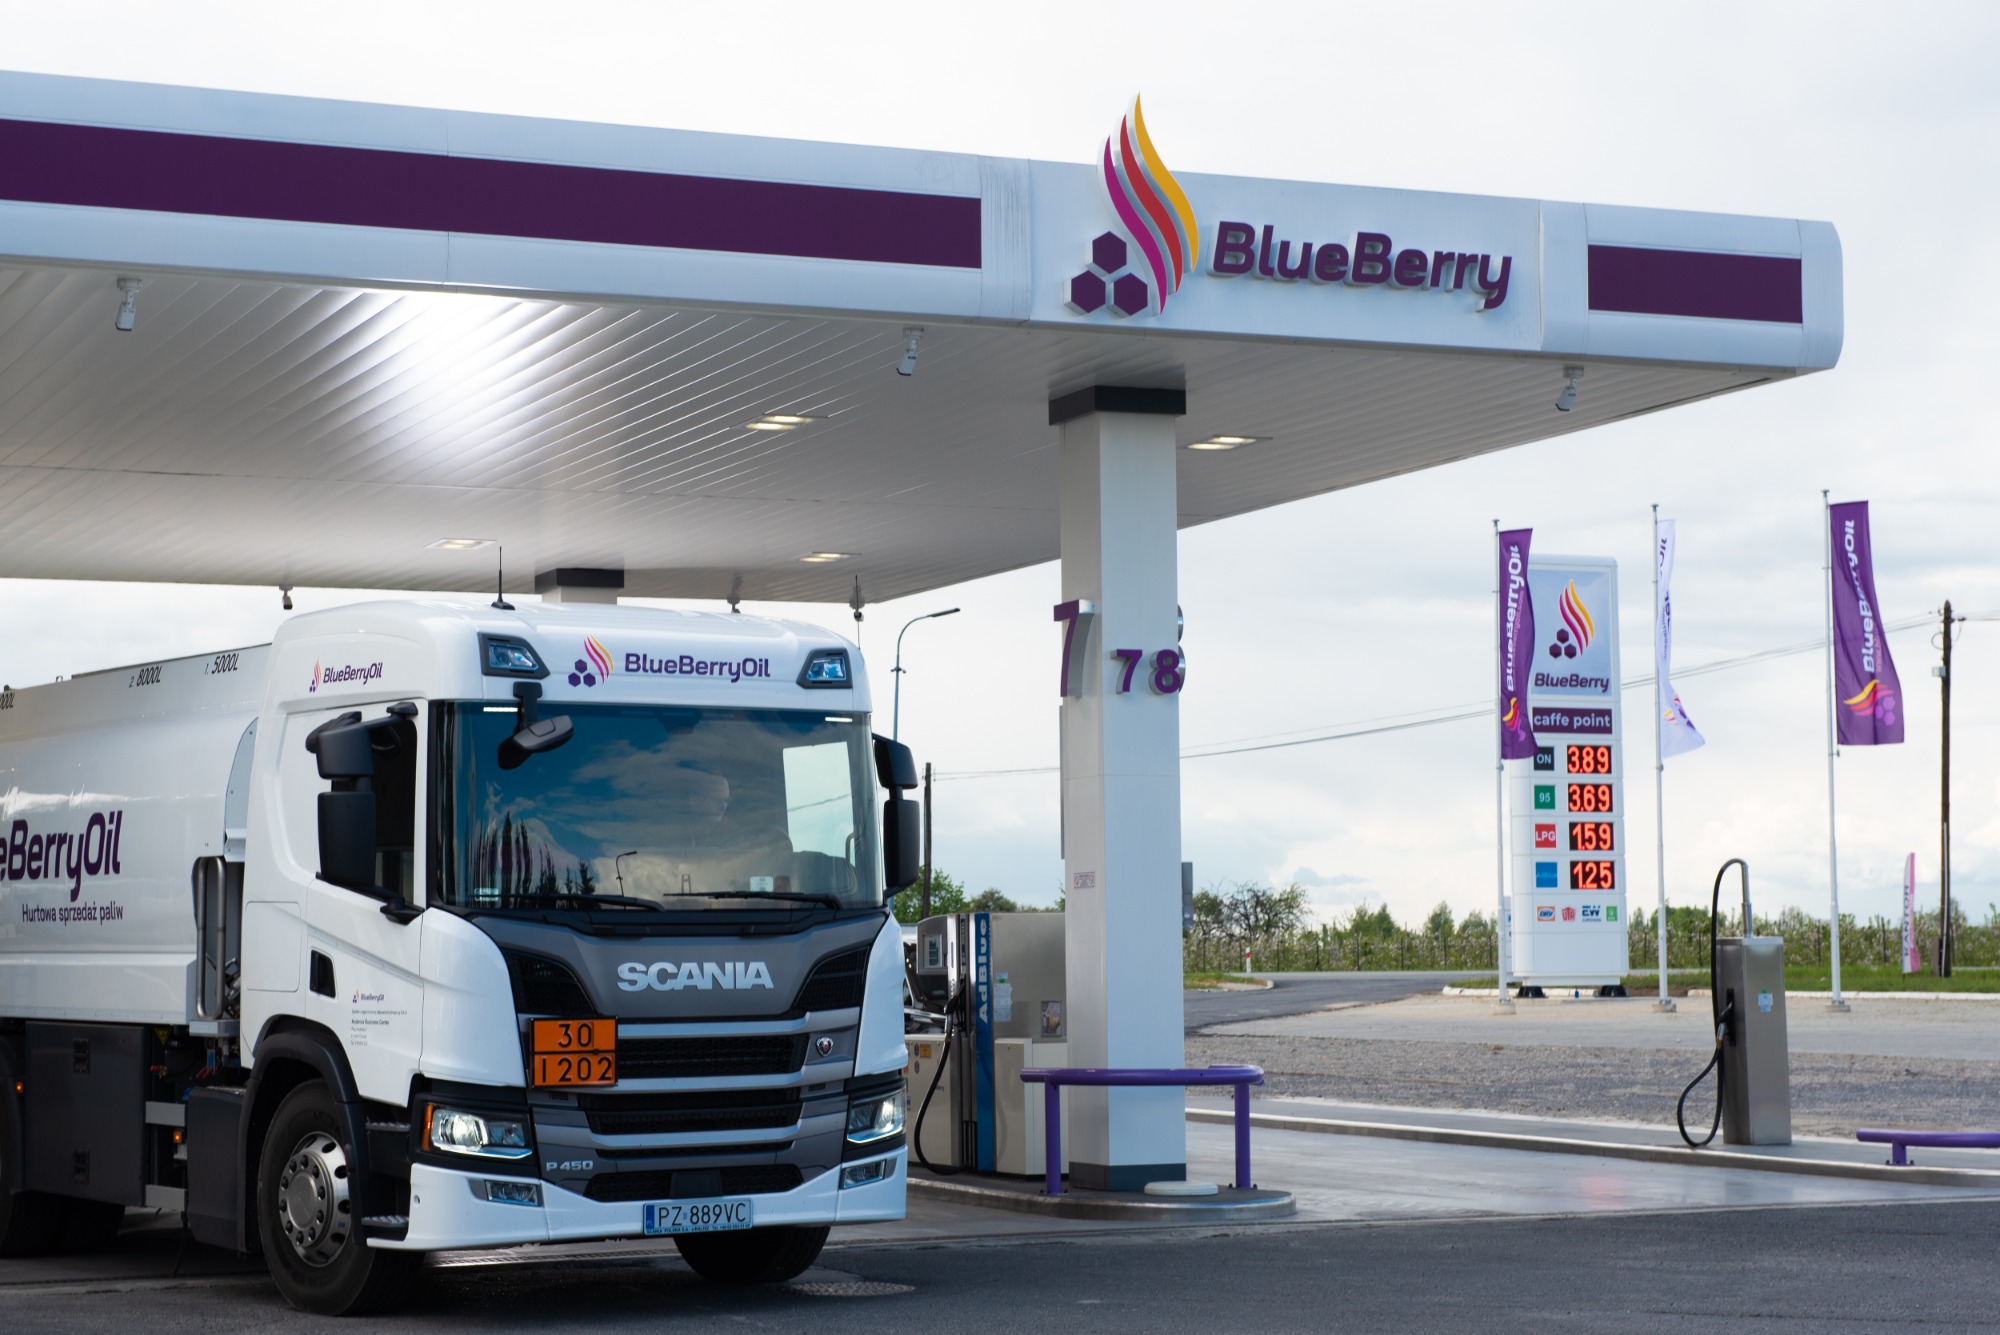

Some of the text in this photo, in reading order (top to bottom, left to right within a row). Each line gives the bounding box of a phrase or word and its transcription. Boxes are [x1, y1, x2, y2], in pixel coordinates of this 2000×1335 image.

[1211, 220, 1512, 310] BlueBerry
[1506, 544, 1524, 692] BlueBerryOil
[1053, 599, 1083, 698] 7
[136, 665, 162, 687] 8000L
[211, 653, 240, 674] 5000L
[323, 662, 383, 685] BlueBerryOil
[625, 653, 770, 683] BlueBerryOil
[1115, 648, 1181, 694] 7 8
[1534, 672, 1609, 693] BlueBerry
[1533, 713, 1610, 729] caffe point
[1536, 745, 1609, 774] ON 3.89
[1539, 784, 1610, 812] 95 3.69
[1535, 822, 1611, 851] LPG 1.59
[1573, 861, 1612, 890] 1.25
[22, 900, 123, 926] Hurtowa sprzedaż paliw
[617, 961, 774, 992] SCANIA
[978, 918, 988, 1024] AdBlue
[558, 1023, 593, 1048] 30
[541, 1057, 613, 1082] 1202
[546, 1160, 593, 1171] P 450
